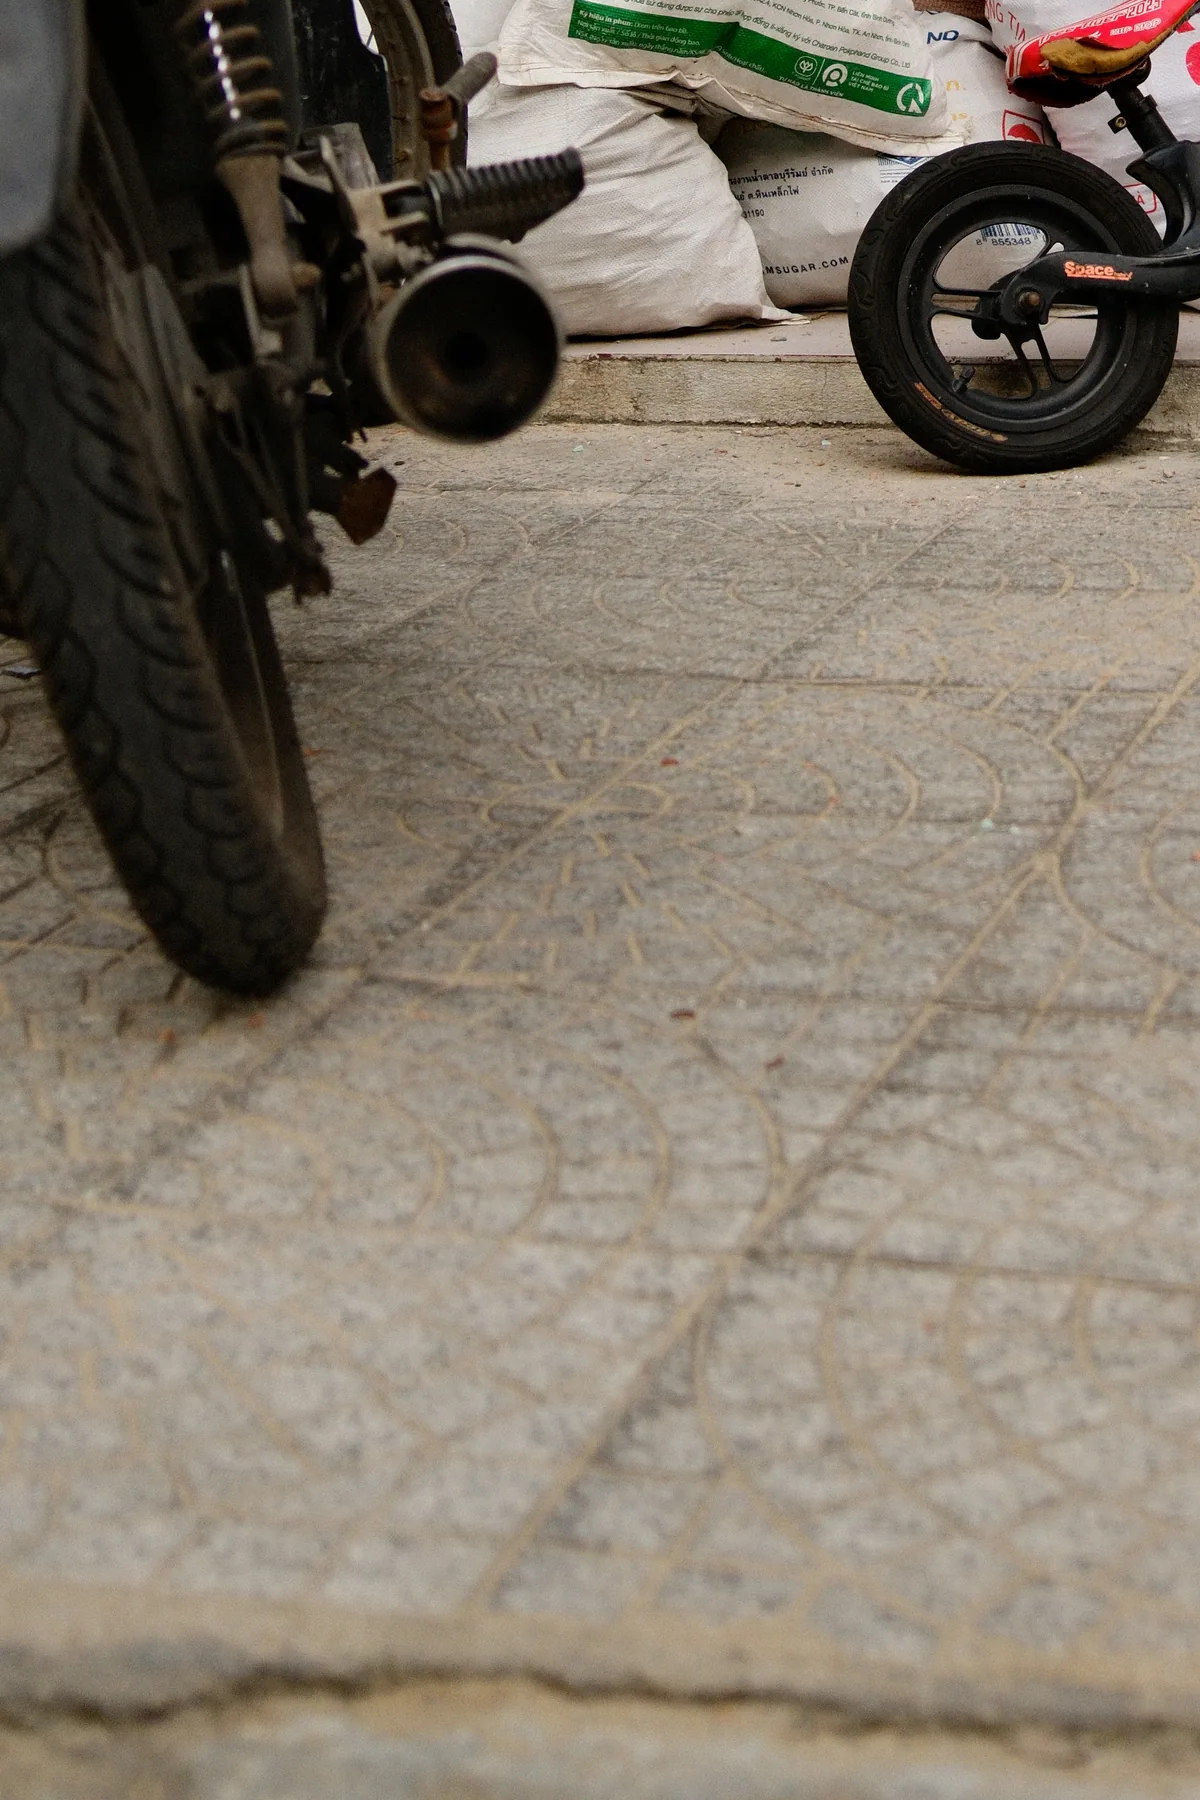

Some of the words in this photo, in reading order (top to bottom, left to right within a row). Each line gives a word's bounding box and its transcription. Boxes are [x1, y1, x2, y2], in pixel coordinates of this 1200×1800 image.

[773, 3, 787, 12] KCN
[589, 12, 605, 22] hiệu
[613, 18, 634, 27] phun:
[704, 7, 718, 16] cho
[871, 54, 890, 65] Group
[861, 85, 874, 93] NAM
[743, 209, 765, 219] 31190
[762, 256, 849, 275] MSUGAR.COM
[1064, 261, 1115, 277] Space
